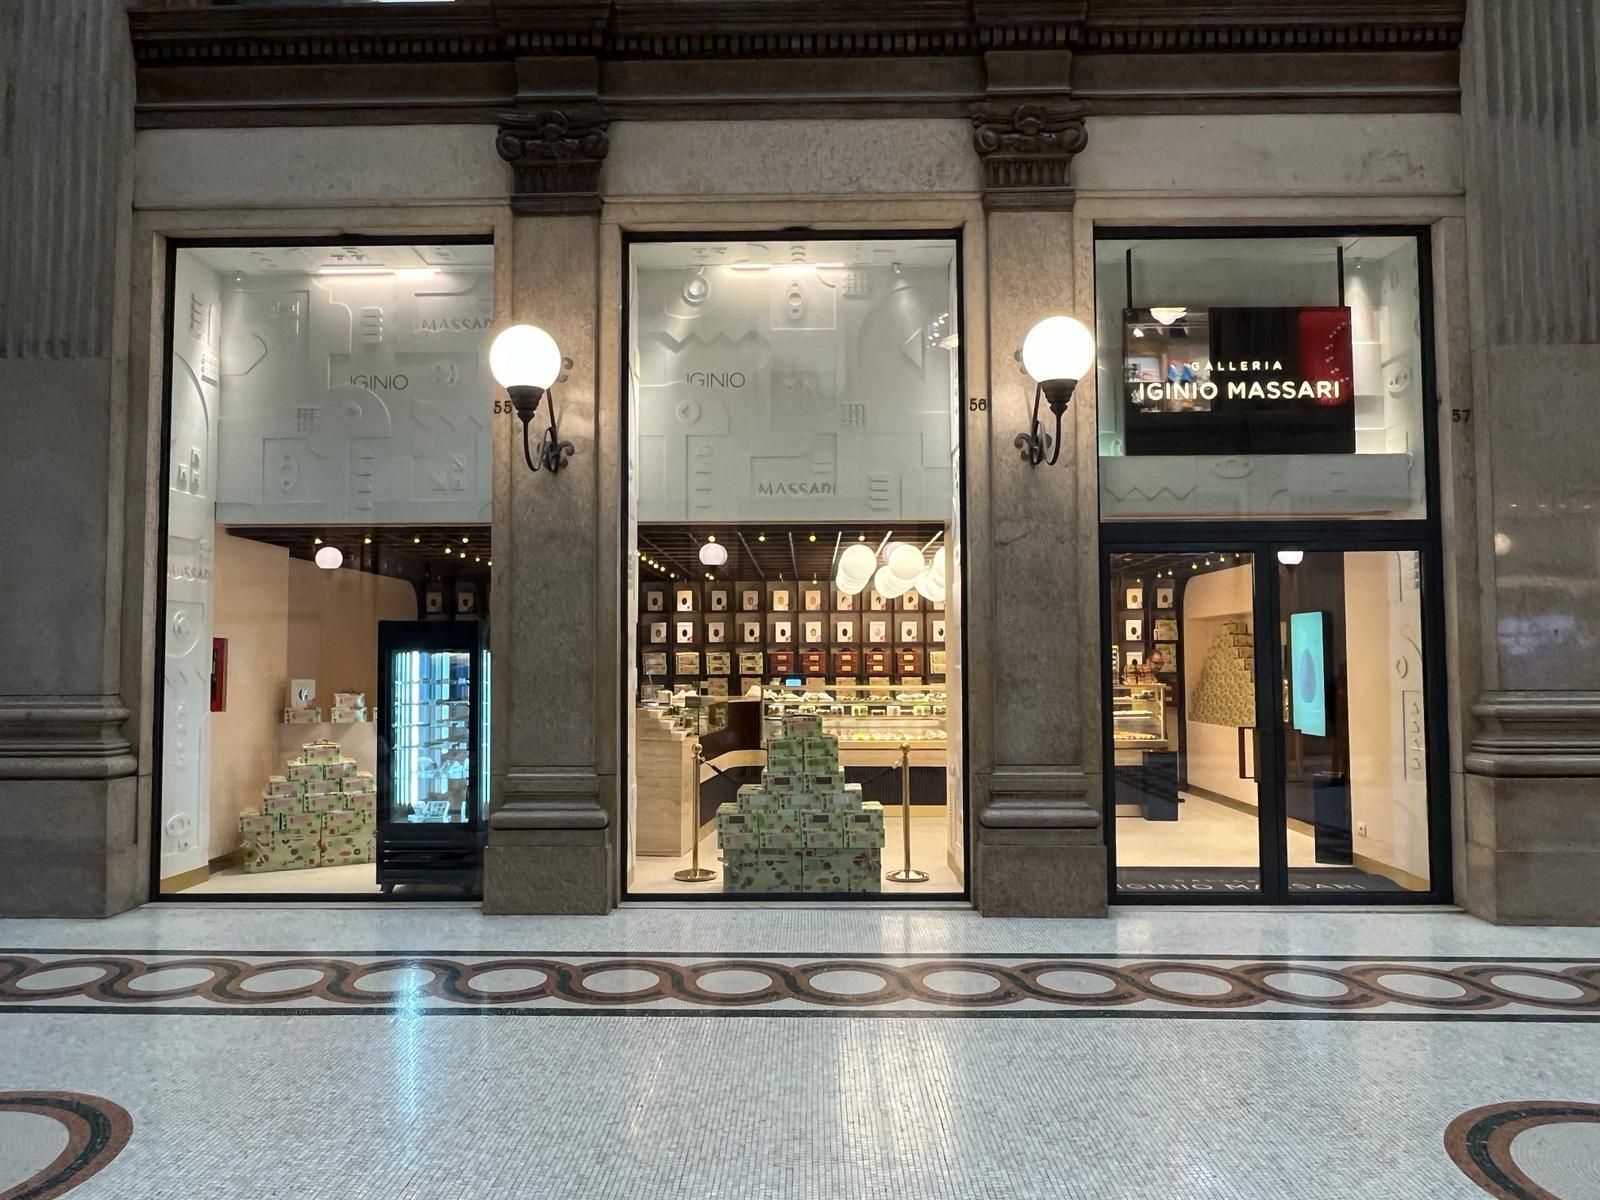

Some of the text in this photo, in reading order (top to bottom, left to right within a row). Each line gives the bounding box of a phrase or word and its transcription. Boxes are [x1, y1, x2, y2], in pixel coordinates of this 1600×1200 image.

[1190, 360, 1283, 372] GALLERIA
[350, 374, 409, 391] IGINIO
[686, 372, 746, 389] IGINIO
[1139, 380, 1340, 400] IGINIO MASSARI
[493, 400, 512, 414] 55
[969, 397, 987, 412] 56
[1451, 408, 1471, 424] 57
[758, 481, 836, 497] MASSARI
